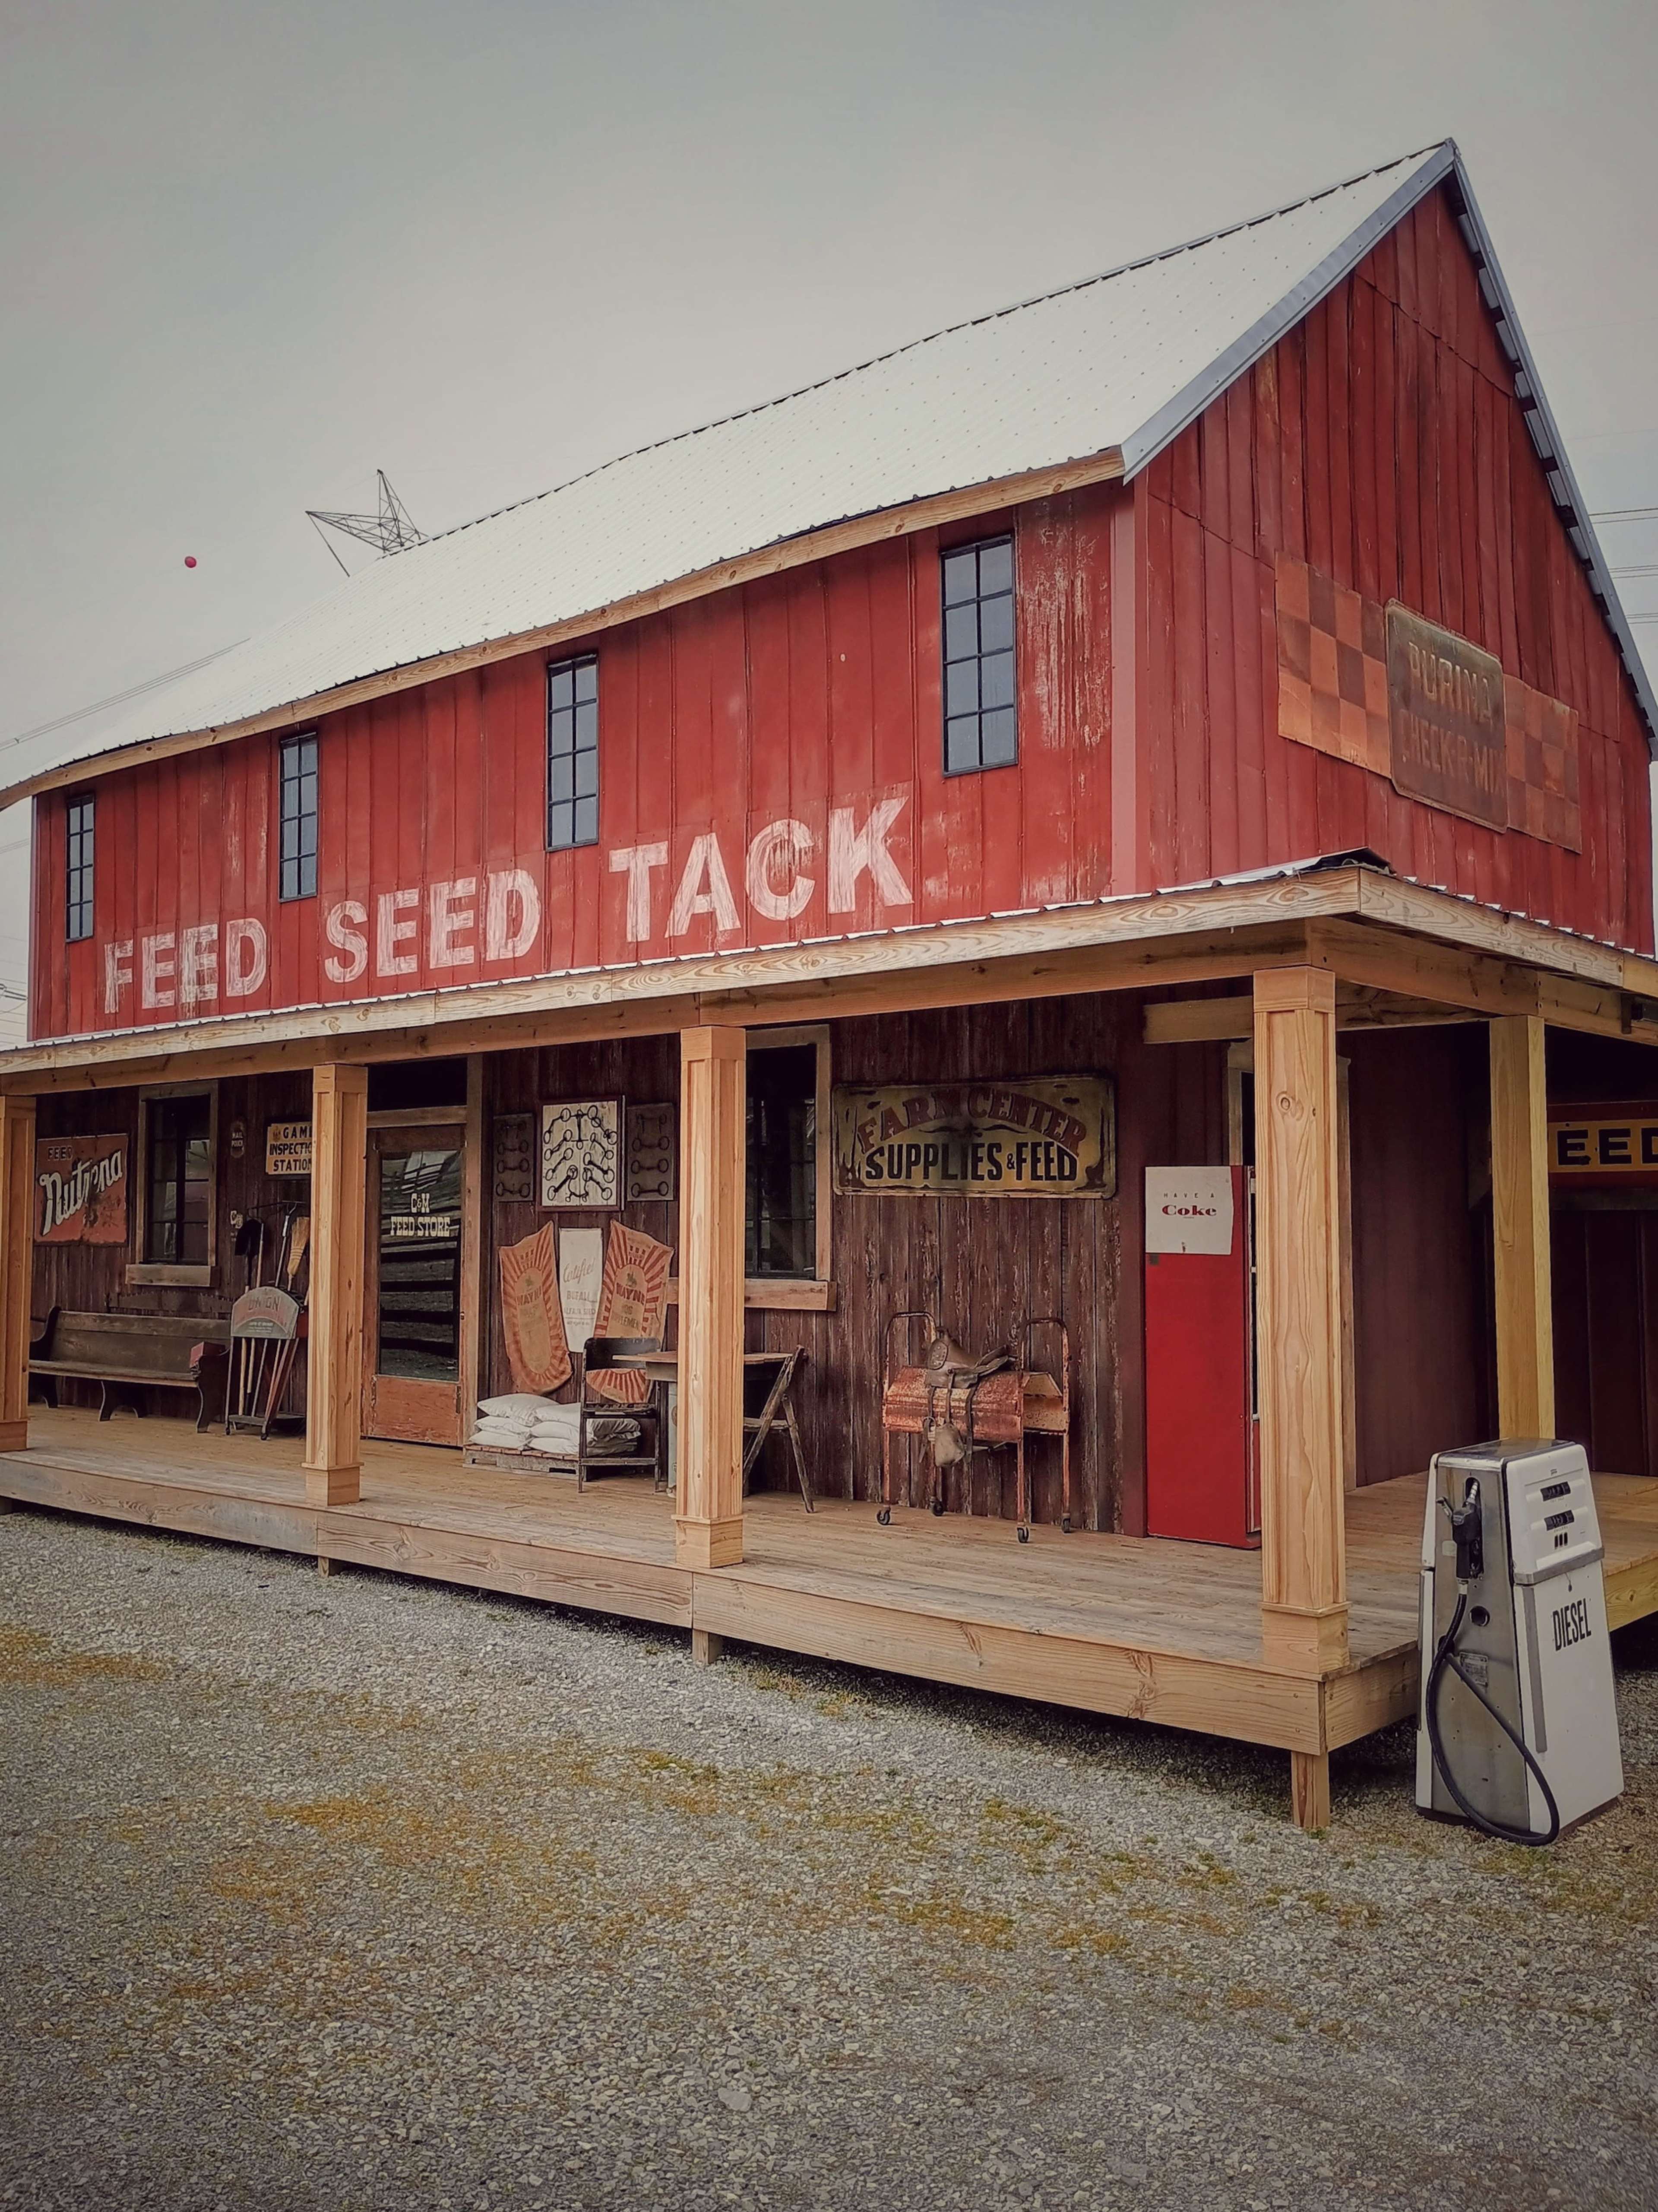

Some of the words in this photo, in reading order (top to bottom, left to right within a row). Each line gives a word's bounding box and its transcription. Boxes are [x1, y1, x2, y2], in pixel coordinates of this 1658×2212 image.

[1408, 642, 1493, 732] PURINA
[104, 918, 267, 1015] FEED
[324, 868, 541, 983] SEED
[609, 796, 915, 943] TACK
[855, 1087, 962, 1155] FARM
[967, 1087, 1087, 1158] CENTER
[269, 1141, 312, 1156] INSPECTIO
[865, 1142, 1003, 1181] SUPPLIES
[1007, 1153, 1015, 1170] &
[1016, 1141, 1079, 1181] FEED
[411, 1193, 430, 1213] C&M
[1162, 1204, 1217, 1216] Coke
[390, 1216, 414, 1236] FEED
[417, 1216, 450, 1237] STORE
[616, 1282, 645, 1306] WAYNE
[1552, 1598, 1592, 1651] DIESEL
